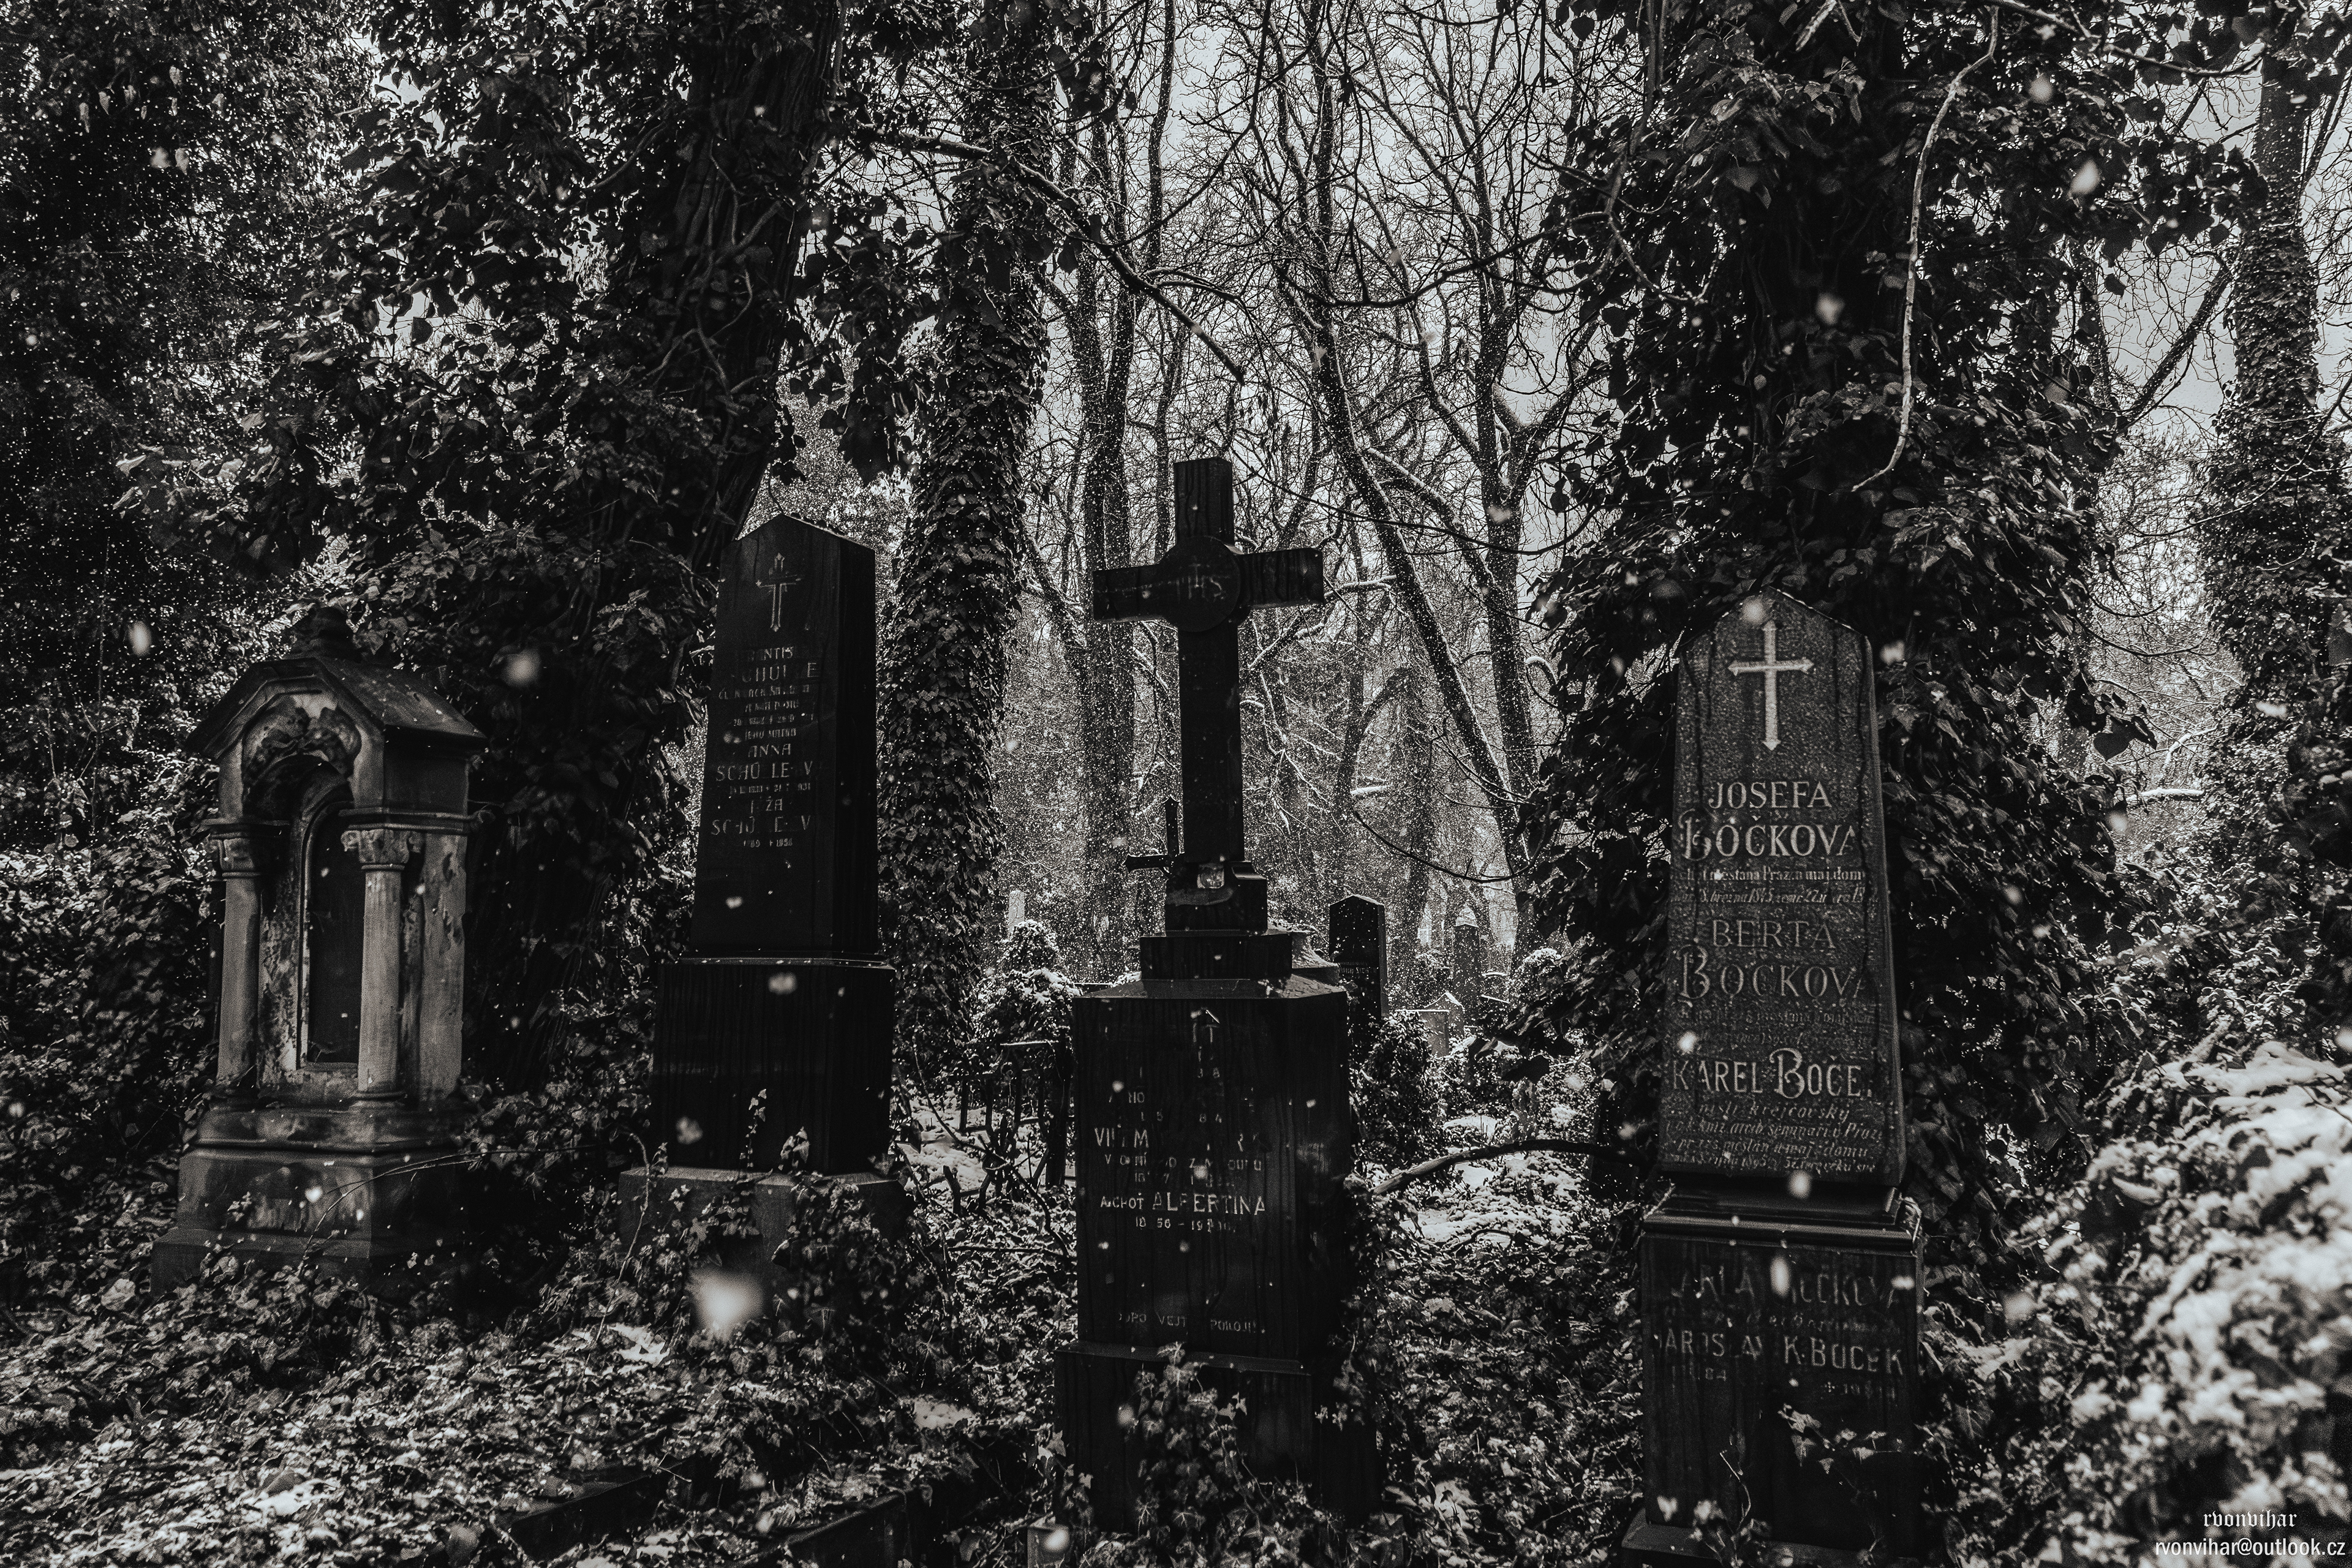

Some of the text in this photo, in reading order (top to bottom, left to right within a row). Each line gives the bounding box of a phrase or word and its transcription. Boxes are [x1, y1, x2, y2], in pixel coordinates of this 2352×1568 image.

[1708, 781, 1833, 809] JOSEFA
[1713, 920, 1836, 949] BERTA
[1673, 1059, 1763, 1094] KAREL
